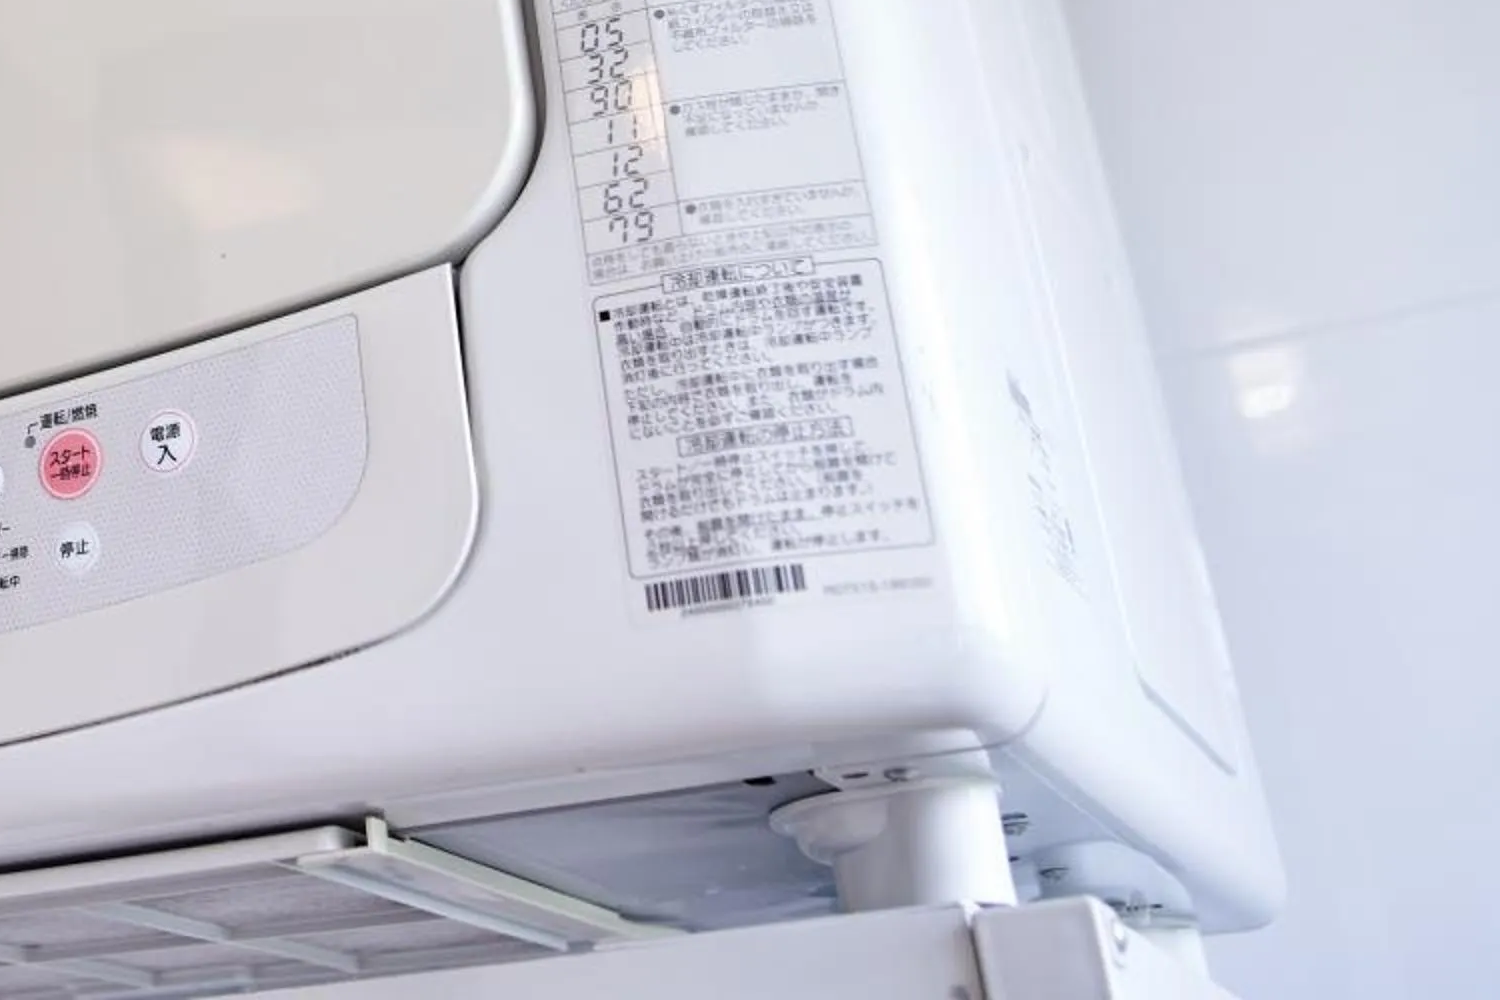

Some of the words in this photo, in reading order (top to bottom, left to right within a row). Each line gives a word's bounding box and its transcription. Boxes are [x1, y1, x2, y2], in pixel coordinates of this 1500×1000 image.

[581, 18, 624, 54] 05
[588, 48, 629, 84] 32
[612, 146, 643, 177] 12
[604, 178, 648, 213] 62
[609, 211, 654, 243] 79
[149, 421, 181, 442] 電源
[49, 444, 92, 467] スタート
[156, 444, 178, 466] 入
[58, 538, 91, 559] 停止
